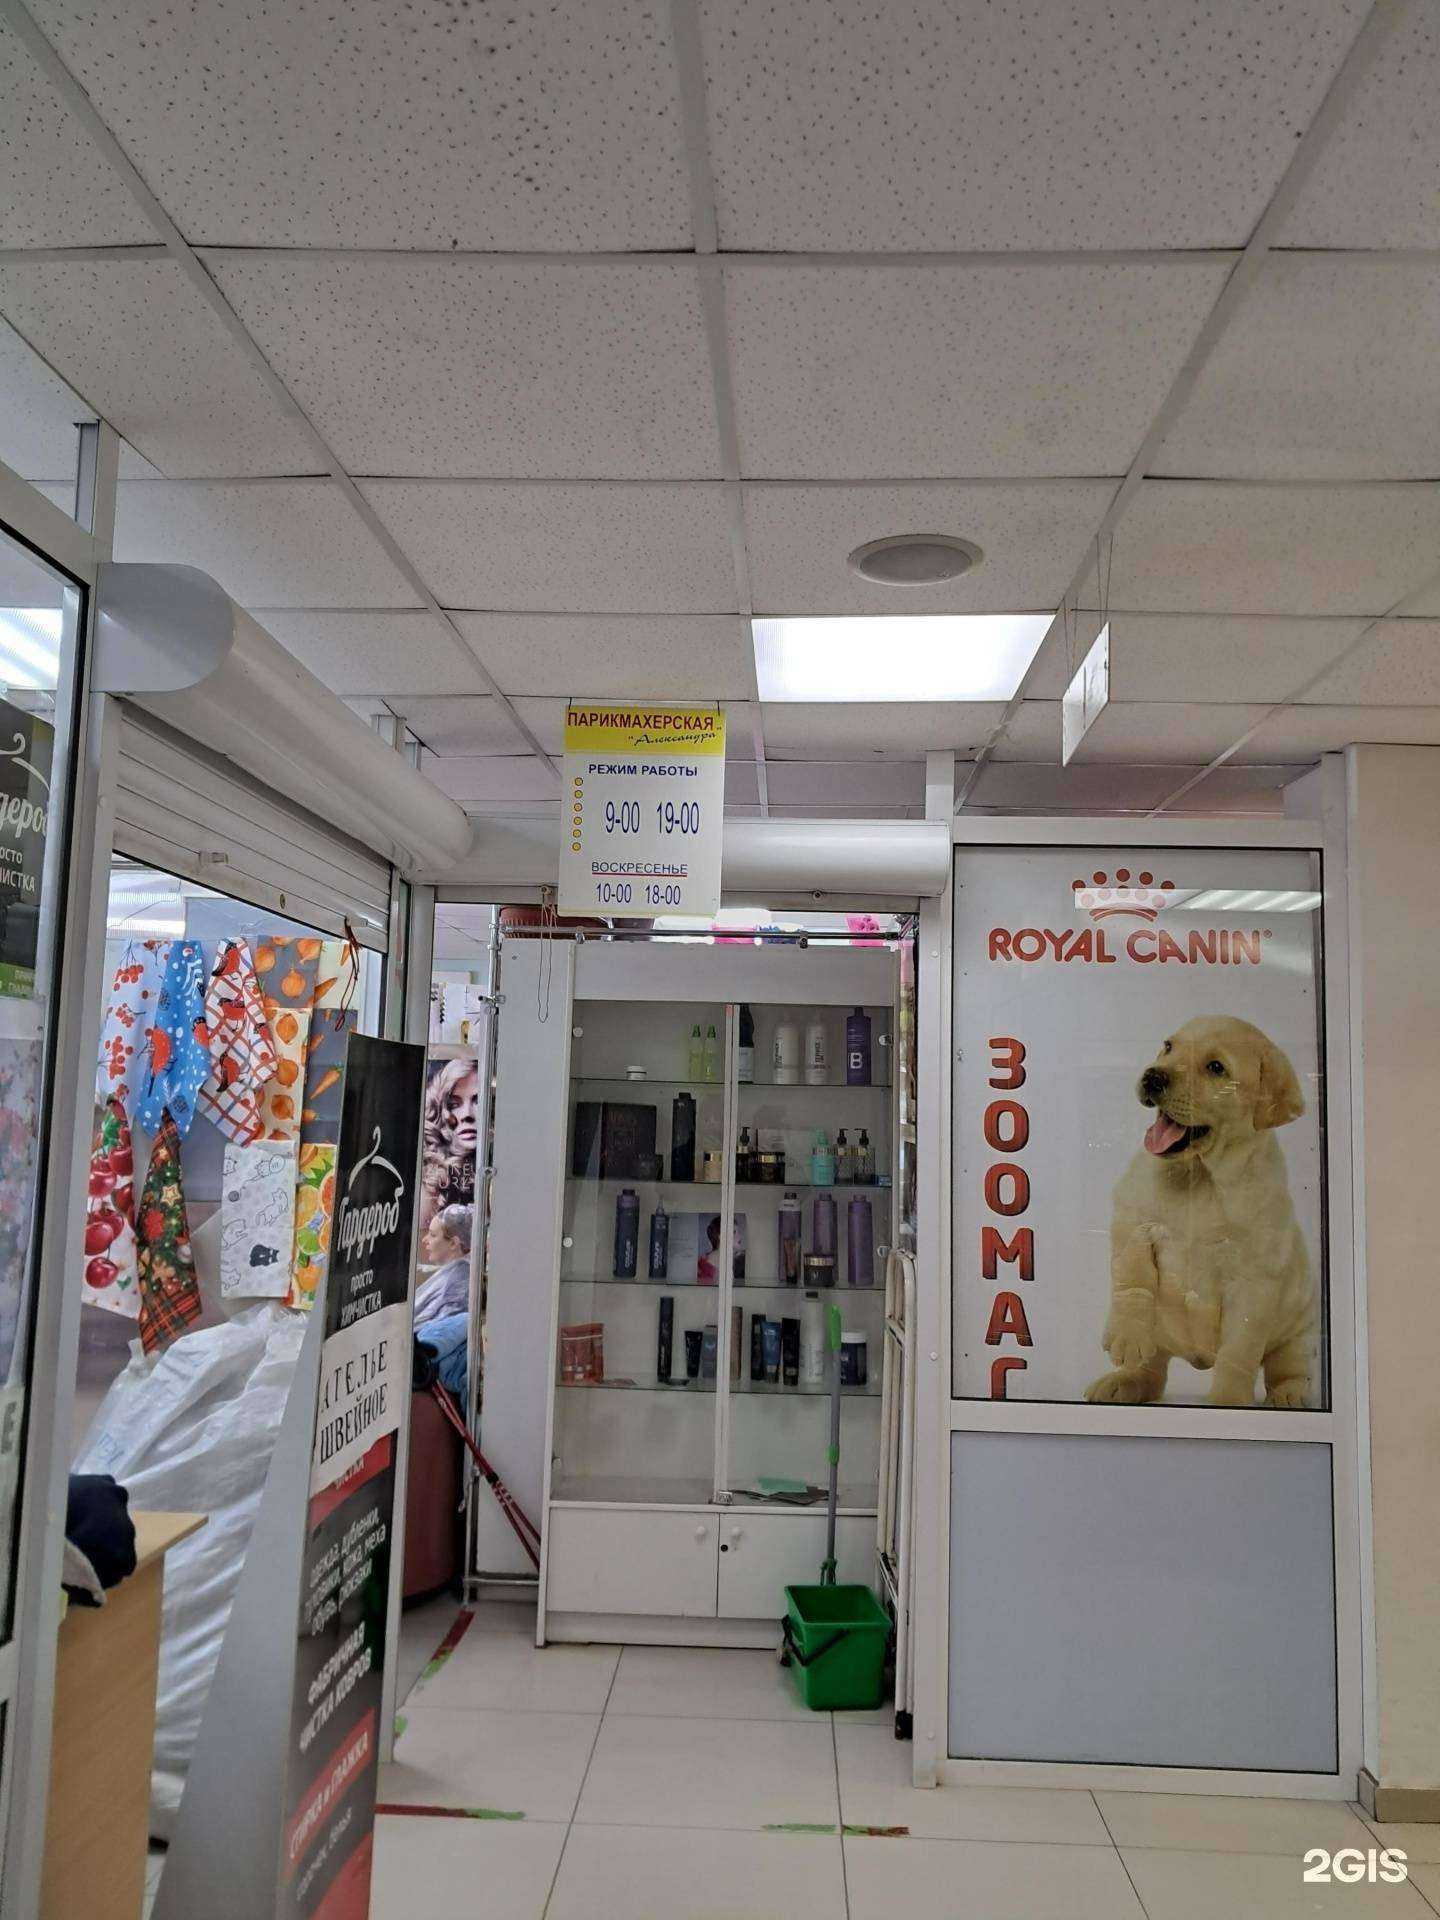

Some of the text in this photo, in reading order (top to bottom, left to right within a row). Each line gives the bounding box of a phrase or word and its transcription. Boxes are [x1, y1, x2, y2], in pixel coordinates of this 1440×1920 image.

[567, 712, 715, 731] ПАРИКМАХЕРСКАЯ
[588, 764, 698, 776] РЕЖИМ РАБОТЫ
[605, 801, 700, 834] 9-00 19-00
[591, 861, 688, 874] ВОСКРЕСЕНЬЕ
[596, 883, 681, 905] 10-00 18-00
[988, 927, 1116, 963] ROYAL
[850, 1052, 863, 1069] B
[337, 1190, 402, 1263] Гардероб
[351, 1269, 373, 1296] просто
[321, 1340, 388, 1413] АТЕЛЬЕ
[320, 1383, 388, 1464] ШВЕЙНОЕ
